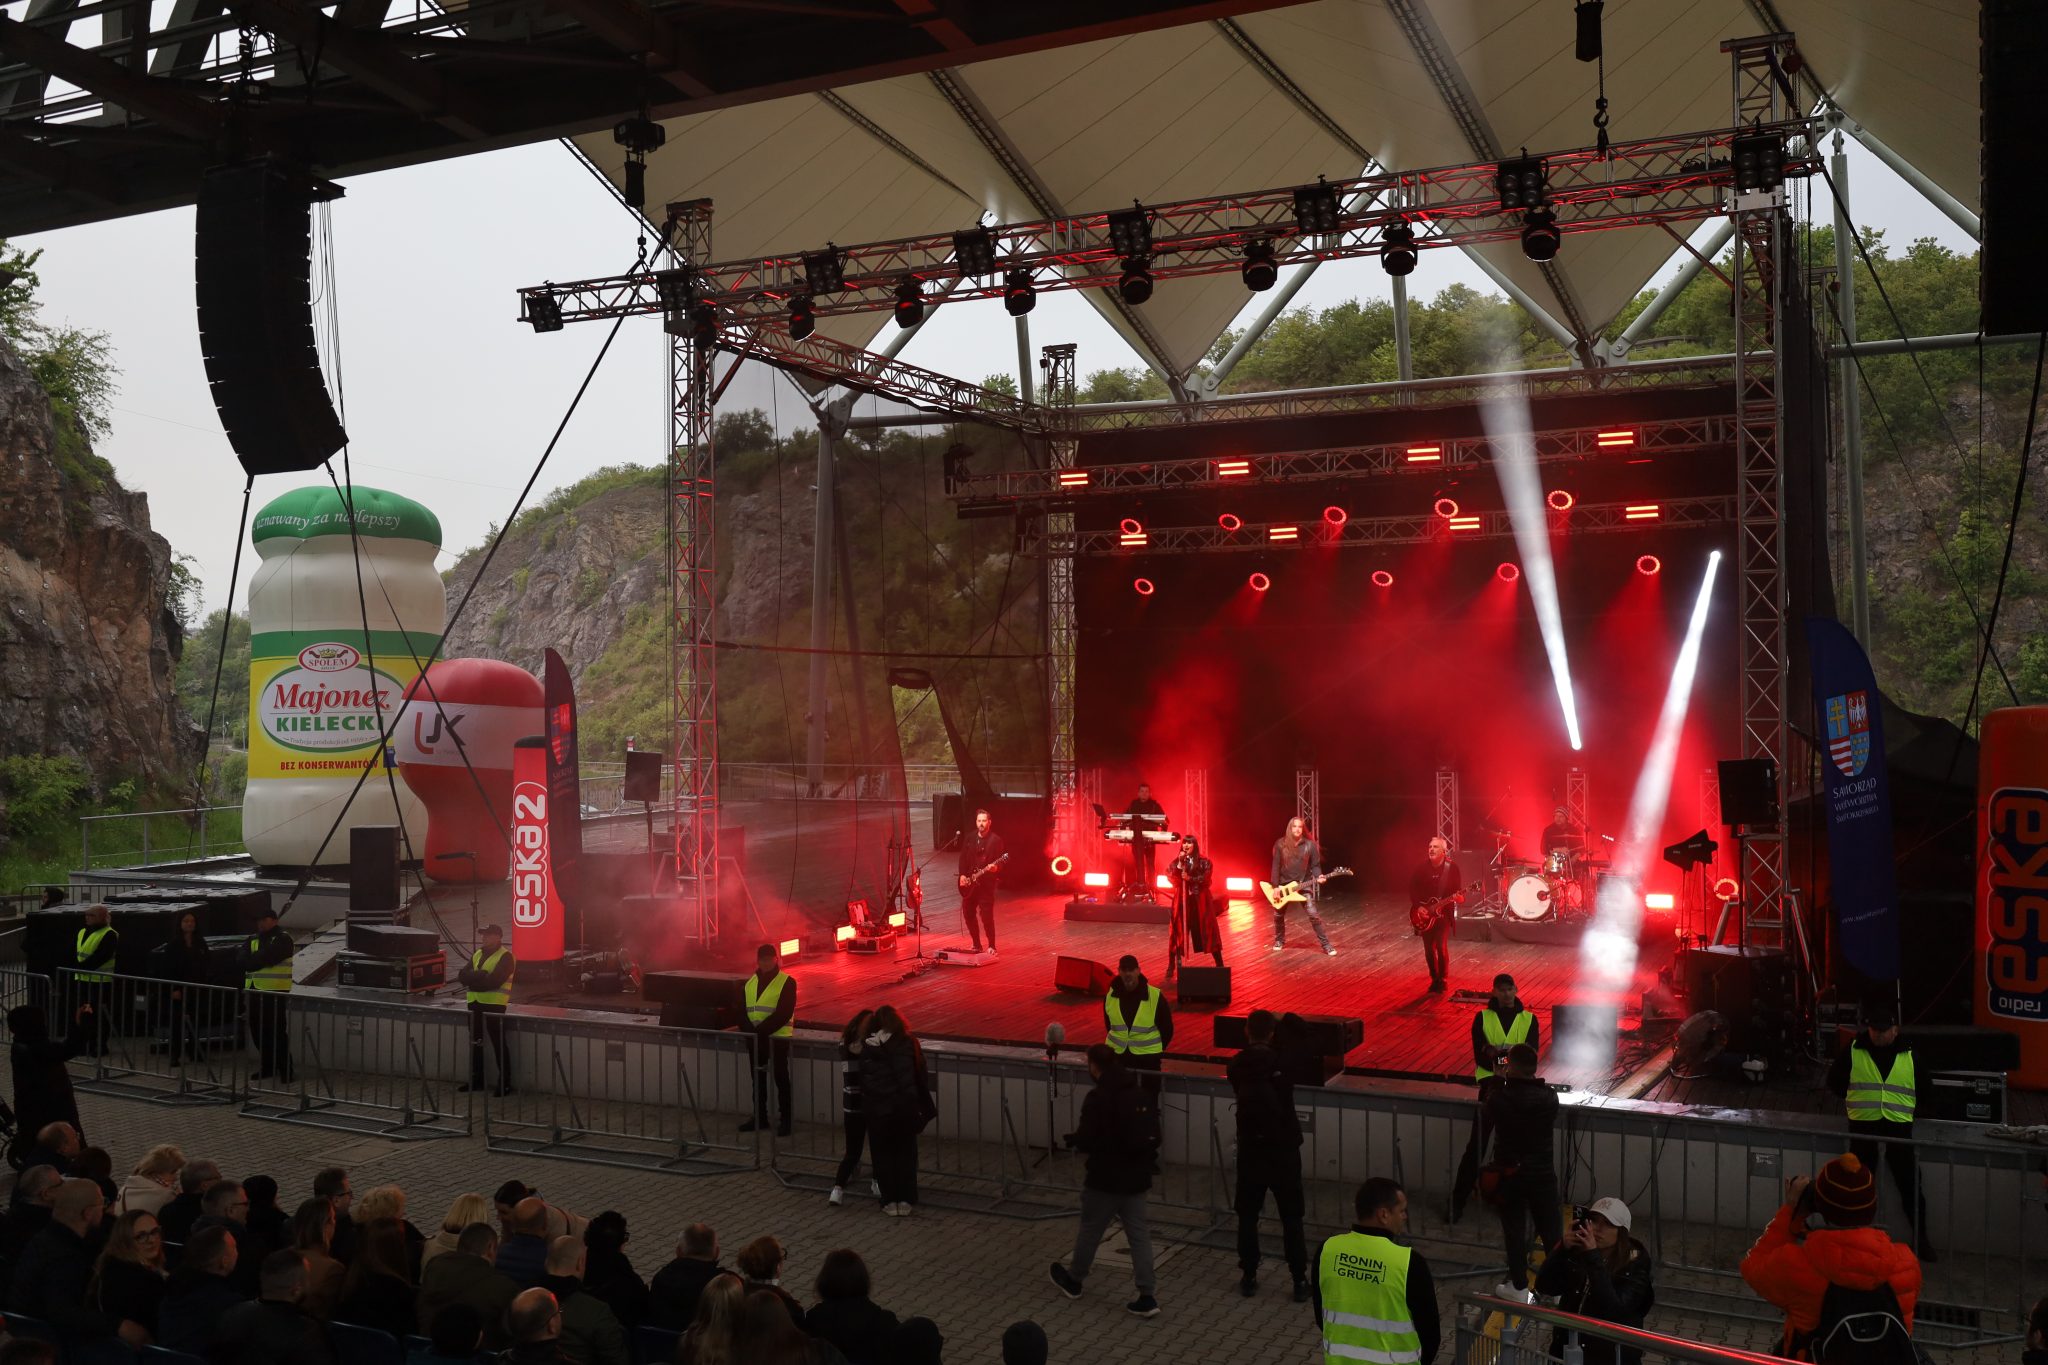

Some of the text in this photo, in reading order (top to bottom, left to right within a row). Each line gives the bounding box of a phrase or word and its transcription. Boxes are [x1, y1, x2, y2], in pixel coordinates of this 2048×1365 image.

[311, 514, 329, 525] za
[273, 682, 390, 714] Majonez
[280, 757, 379, 771] BEZ KONSERWANTÓW
[514, 794, 546, 923] eska2
[1994, 796, 2048, 994] eska
[1998, 996, 2041, 1013] radio
[1340, 1253, 1383, 1270] RONIN
[1337, 1267, 1380, 1285] GRUPA
